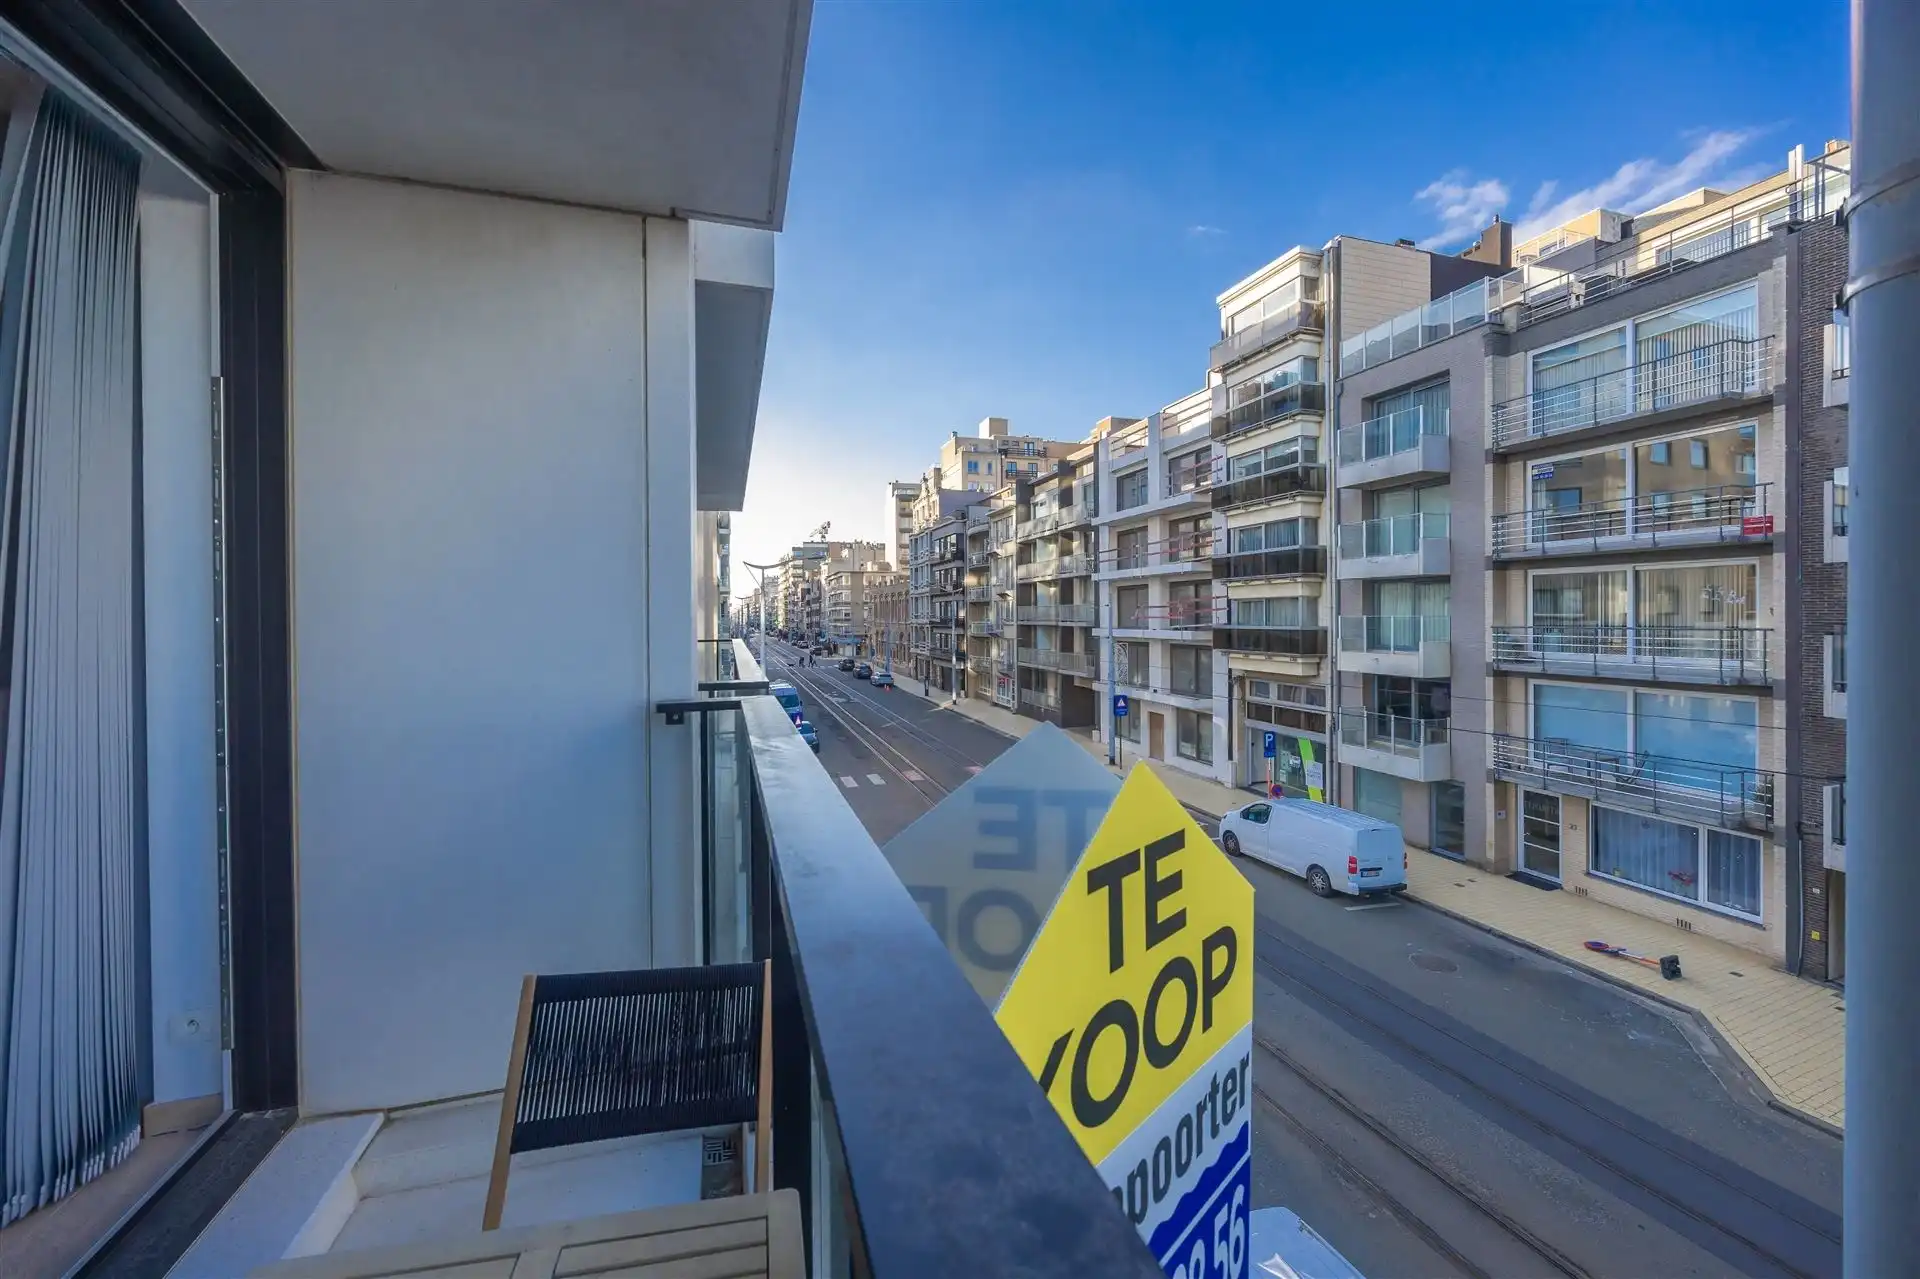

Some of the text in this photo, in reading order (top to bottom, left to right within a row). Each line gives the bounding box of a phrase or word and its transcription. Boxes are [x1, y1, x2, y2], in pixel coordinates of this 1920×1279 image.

[1265, 733, 1274, 748] P
[1087, 828, 1187, 974] TE
[1213, 1183, 1245, 1279] 56
